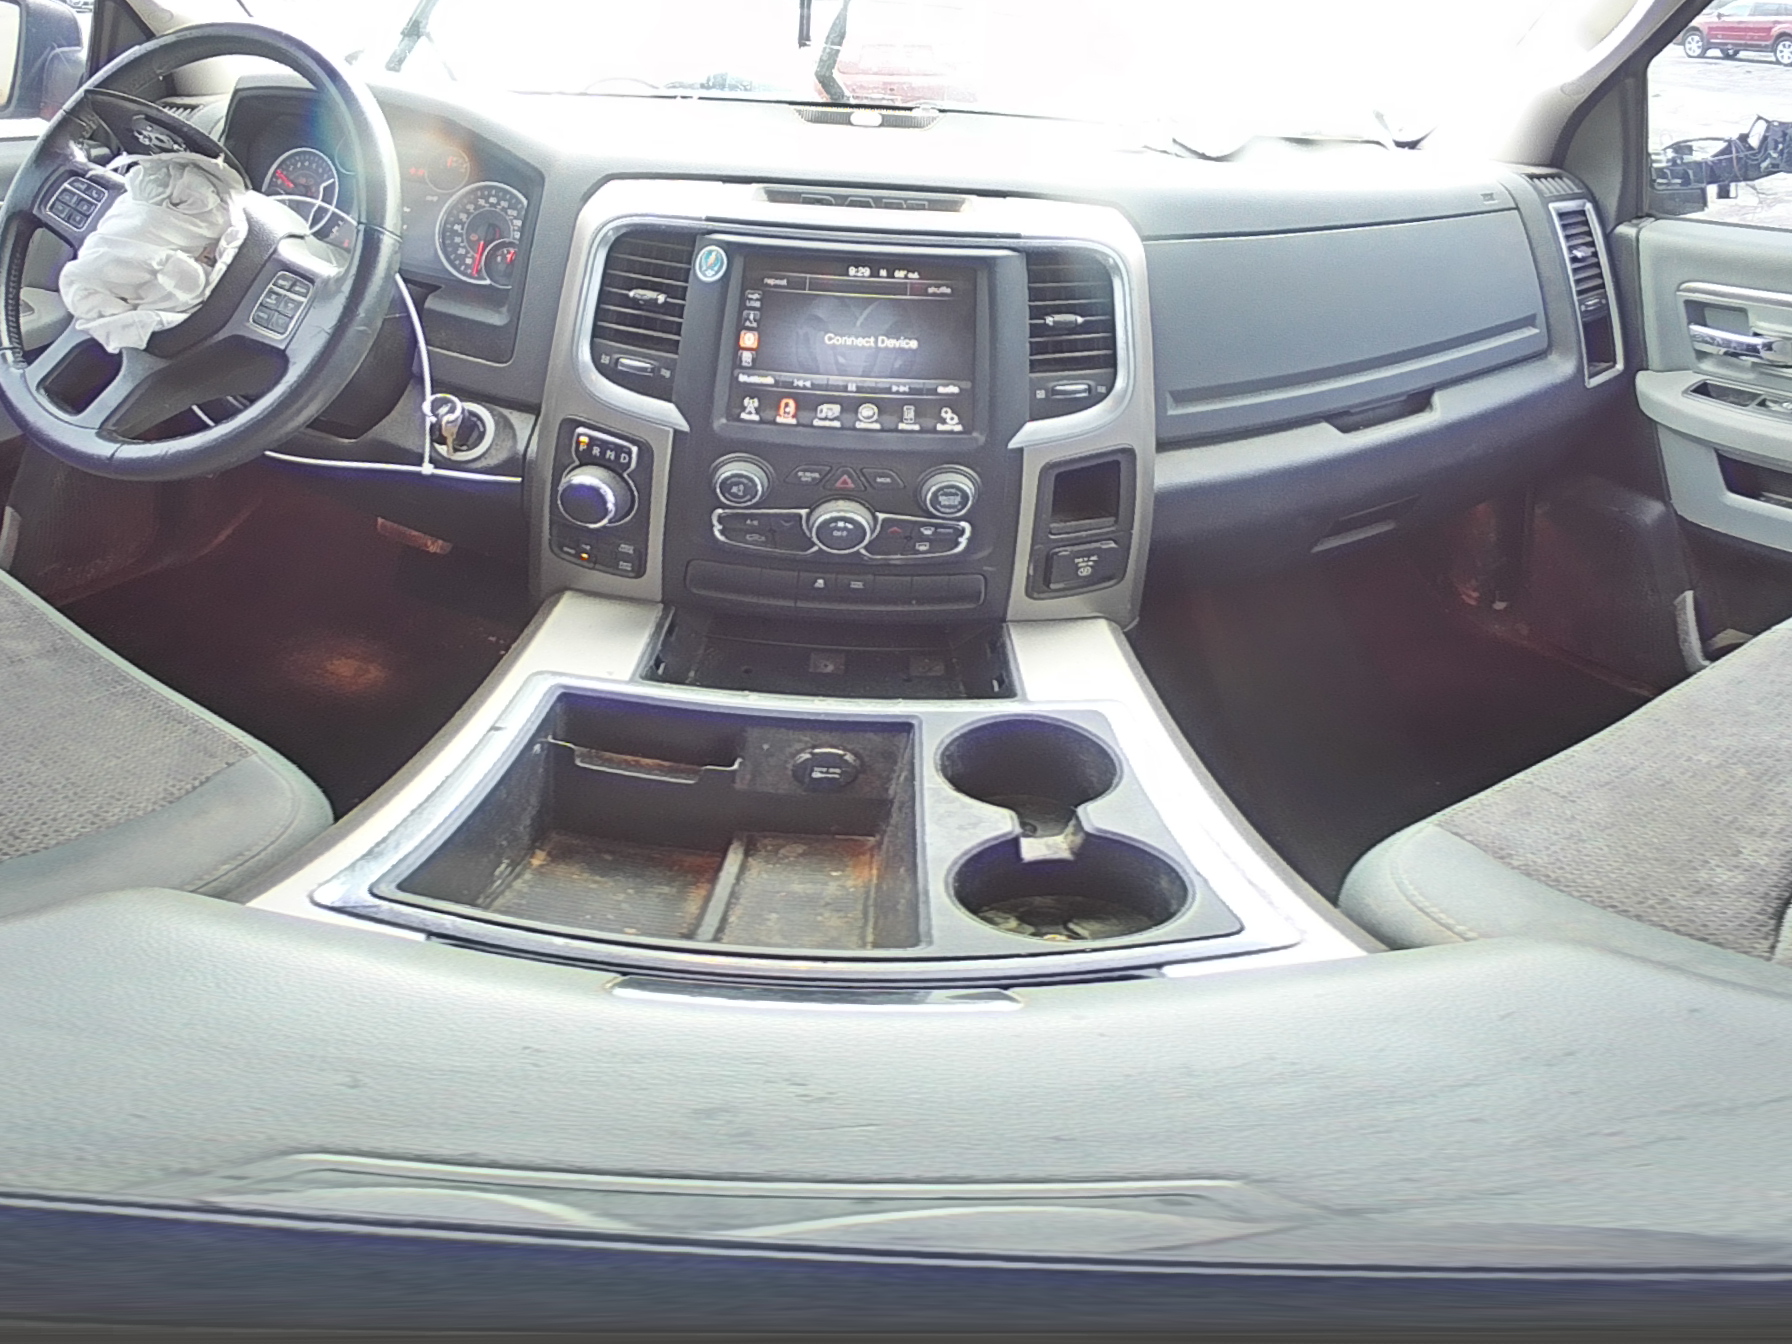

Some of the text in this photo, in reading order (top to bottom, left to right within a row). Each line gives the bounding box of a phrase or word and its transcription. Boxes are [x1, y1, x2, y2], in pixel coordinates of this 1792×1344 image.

[848, 266, 871, 277] 9:29
[824, 332, 919, 349] Connect Device
[592, 446, 600, 457] R
[619, 453, 629, 463] D
